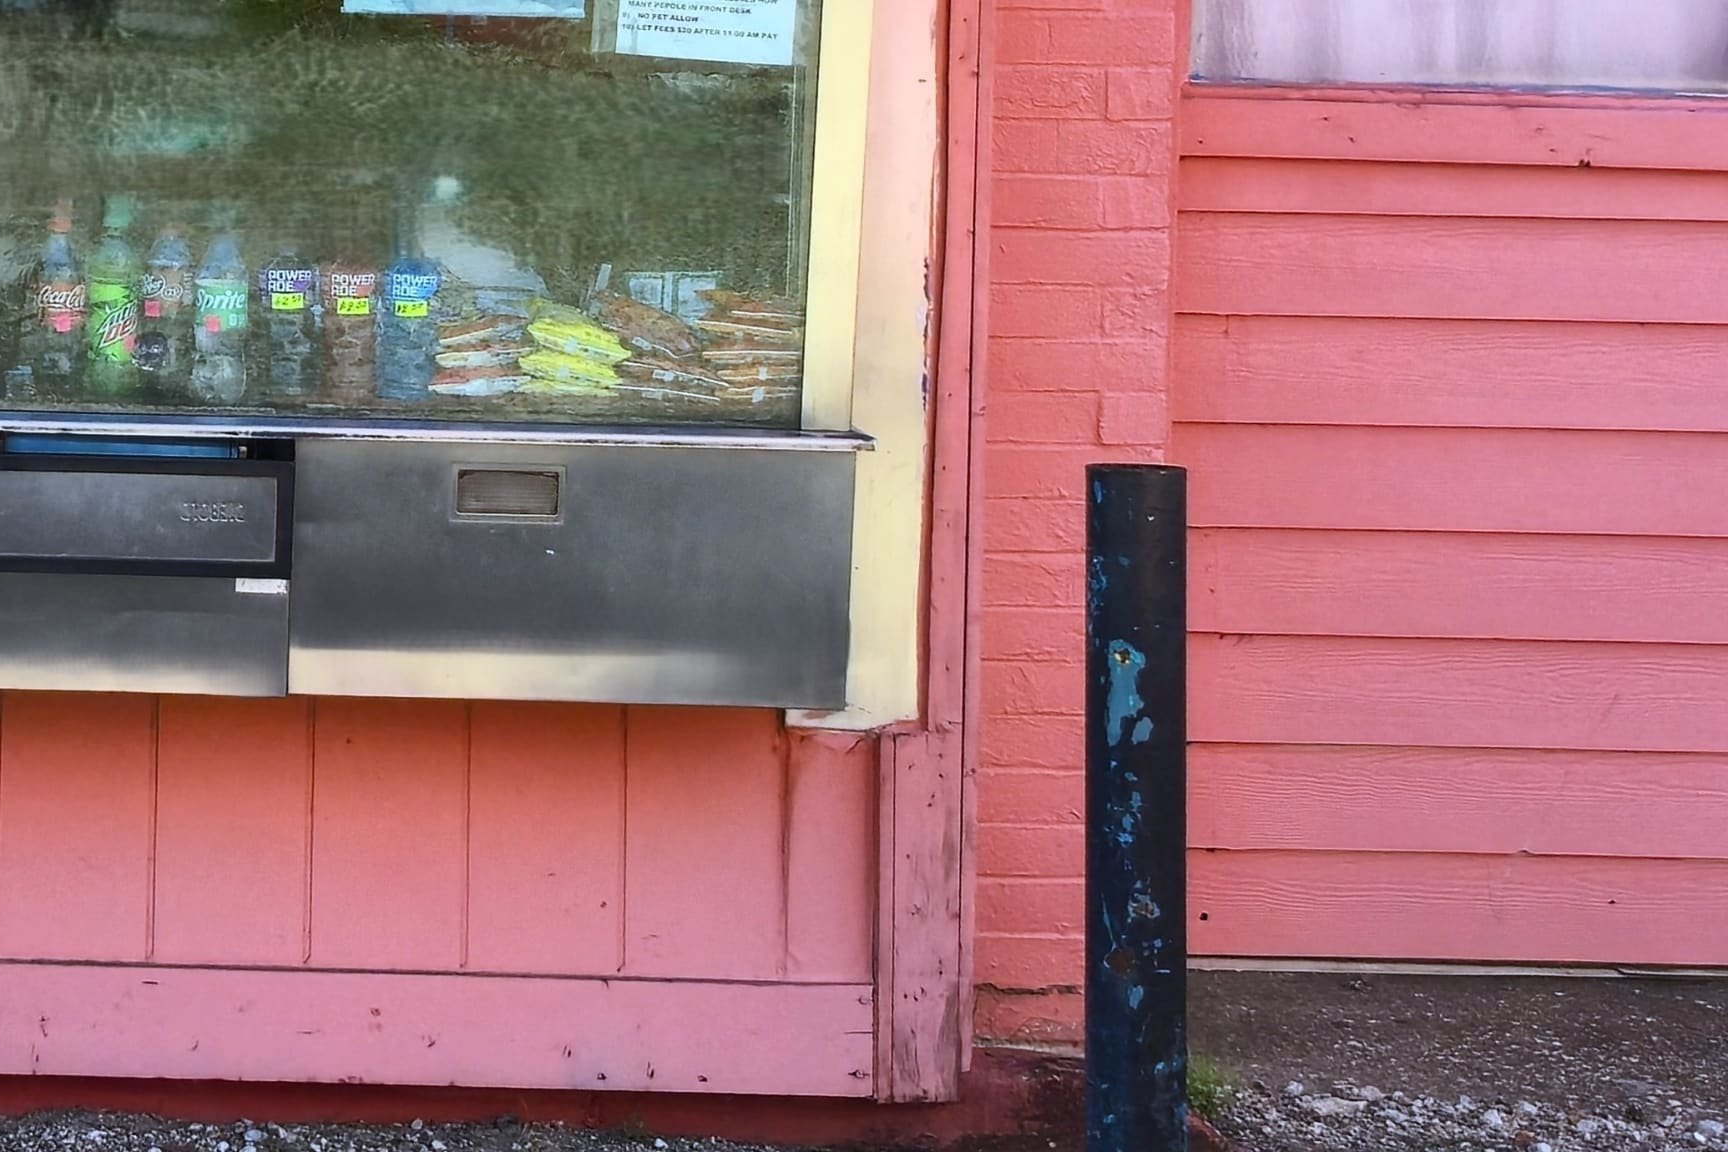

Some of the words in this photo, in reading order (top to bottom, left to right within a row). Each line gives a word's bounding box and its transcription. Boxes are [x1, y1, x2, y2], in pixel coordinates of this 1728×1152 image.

[669, 14, 699, 22] ALLOW
[267, 270, 312, 281] POWER
[331, 273, 375, 285] POWER
[392, 273, 437, 286] POWER
[196, 290, 245, 312] Sprite
